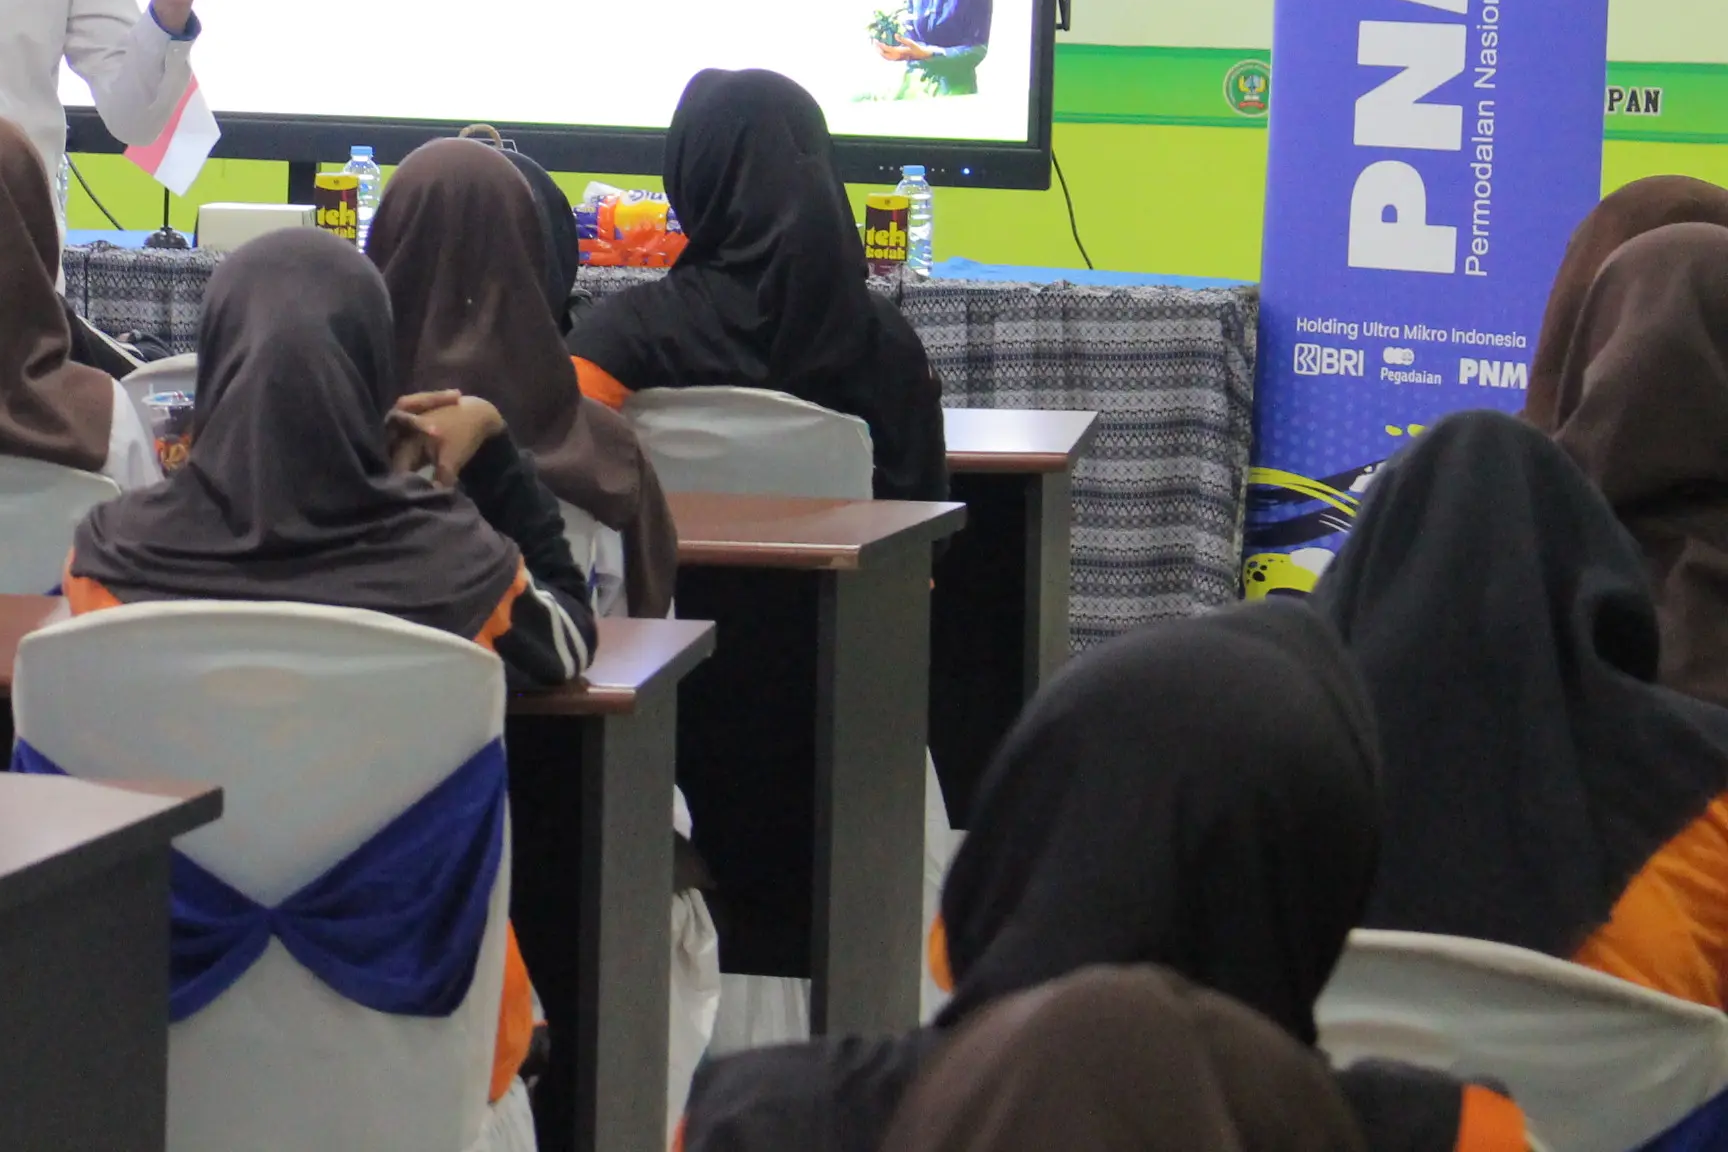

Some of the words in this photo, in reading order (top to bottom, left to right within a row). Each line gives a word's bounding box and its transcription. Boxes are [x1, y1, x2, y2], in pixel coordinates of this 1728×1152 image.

[1606, 87, 1661, 115] PAN
[1465, 100, 1496, 277] Permodalan
[317, 201, 356, 226] teh
[866, 221, 907, 247] teh
[1296, 317, 1359, 340] Holding
[1363, 321, 1400, 339] Ultra
[1403, 324, 1448, 343] Mikro
[1451, 327, 1527, 349] Indonesia
[1322, 347, 1364, 376] BRI
[1380, 367, 1442, 385] Pegadaian
[1459, 358, 1528, 389] PNM
